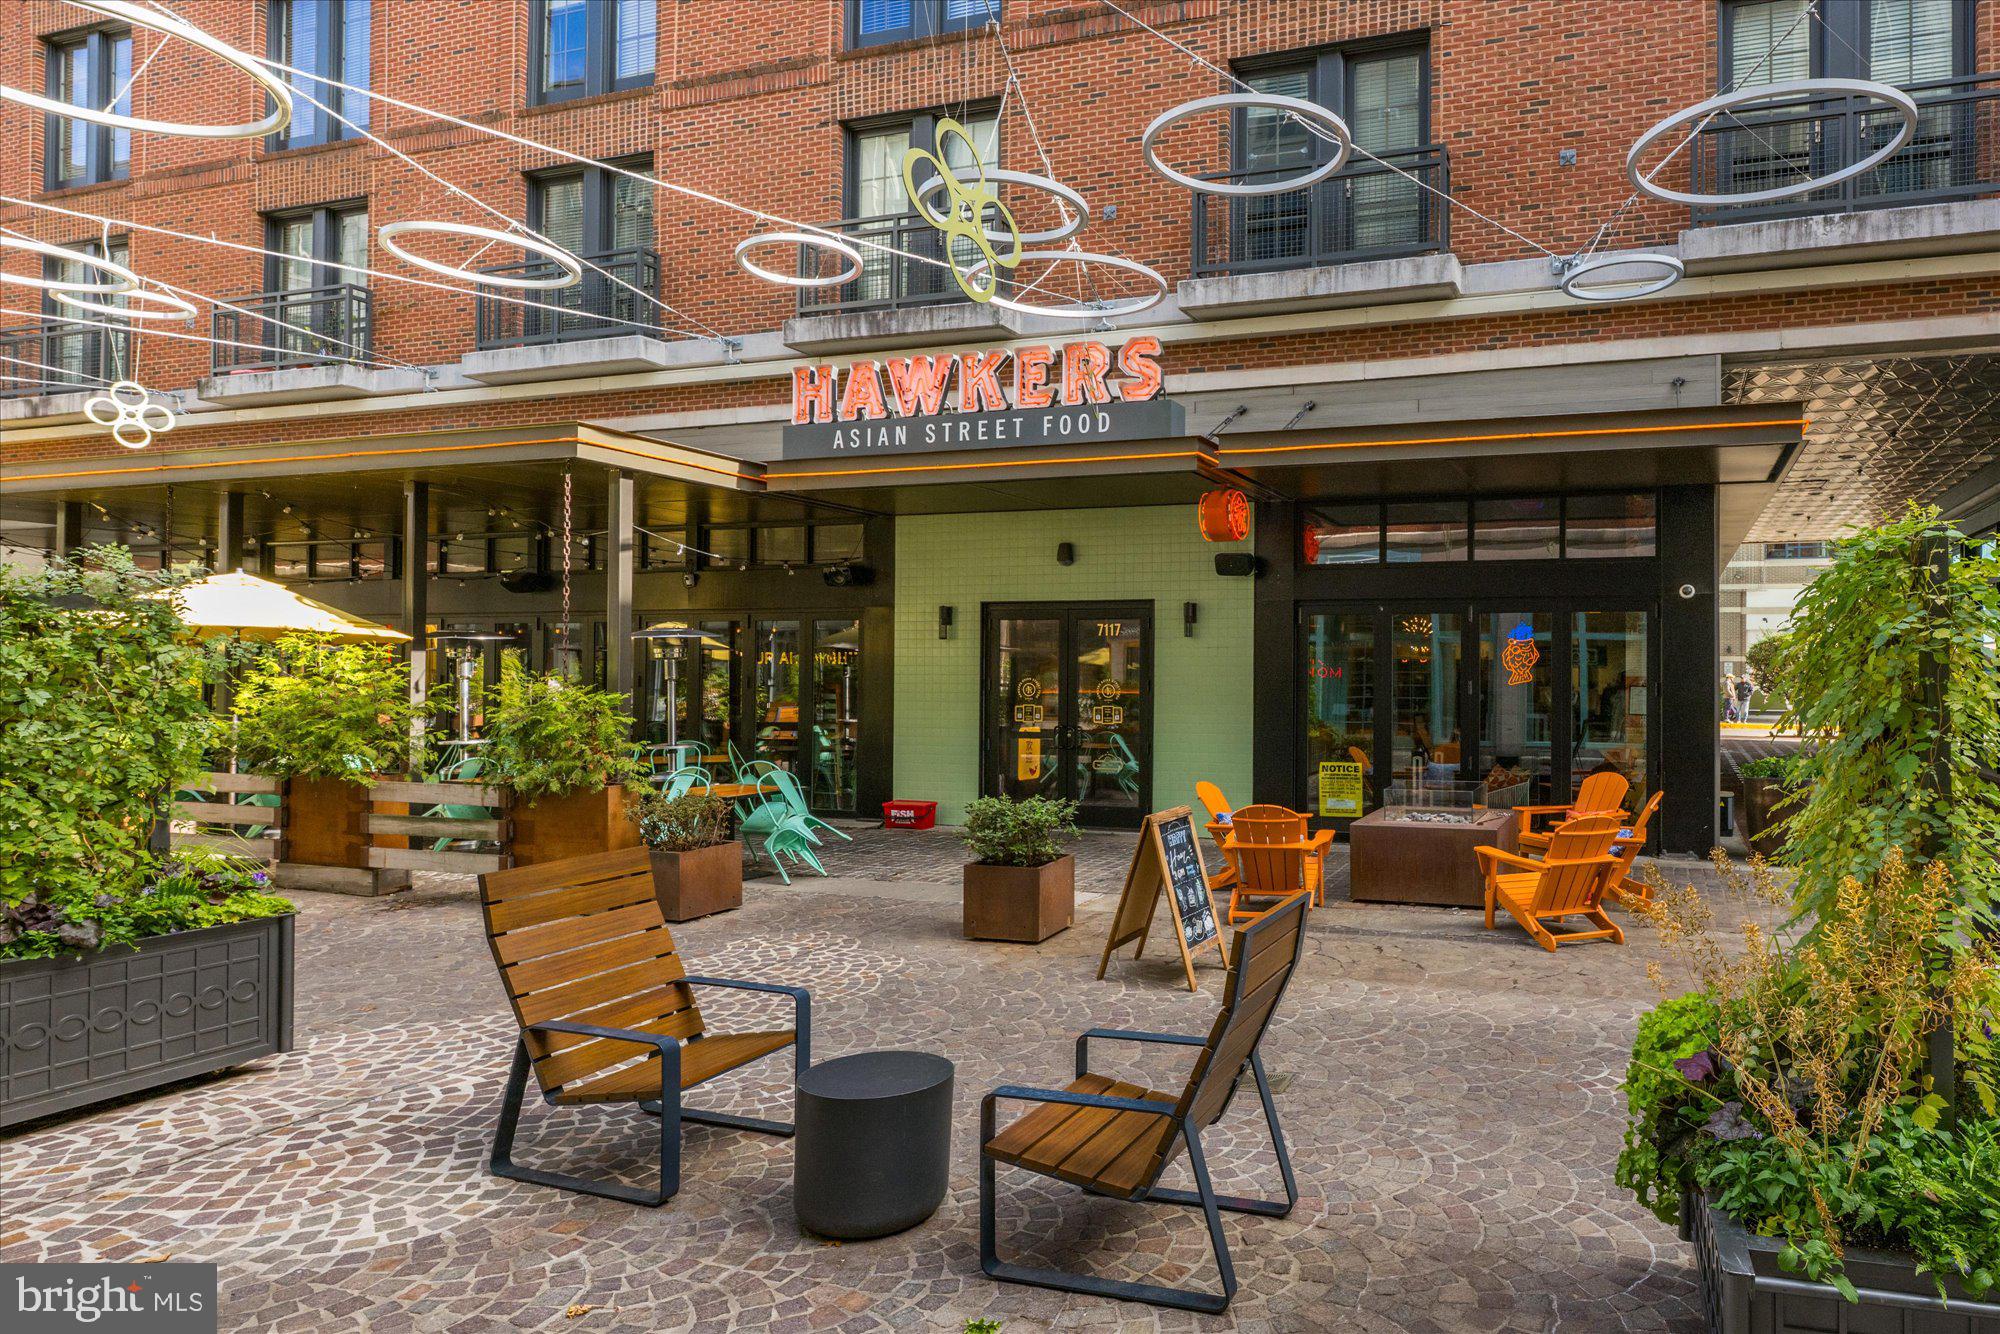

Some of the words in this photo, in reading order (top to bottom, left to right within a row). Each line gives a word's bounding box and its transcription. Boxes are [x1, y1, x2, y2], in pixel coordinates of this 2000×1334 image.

[791, 336, 1165, 425] HAWKERS
[832, 424, 908, 450] ASIAN
[925, 416, 1025, 445] STREET
[1043, 411, 1112, 437] FOOD
[1097, 623, 1121, 637] 7117
[1321, 765, 1360, 773] NOTICE
